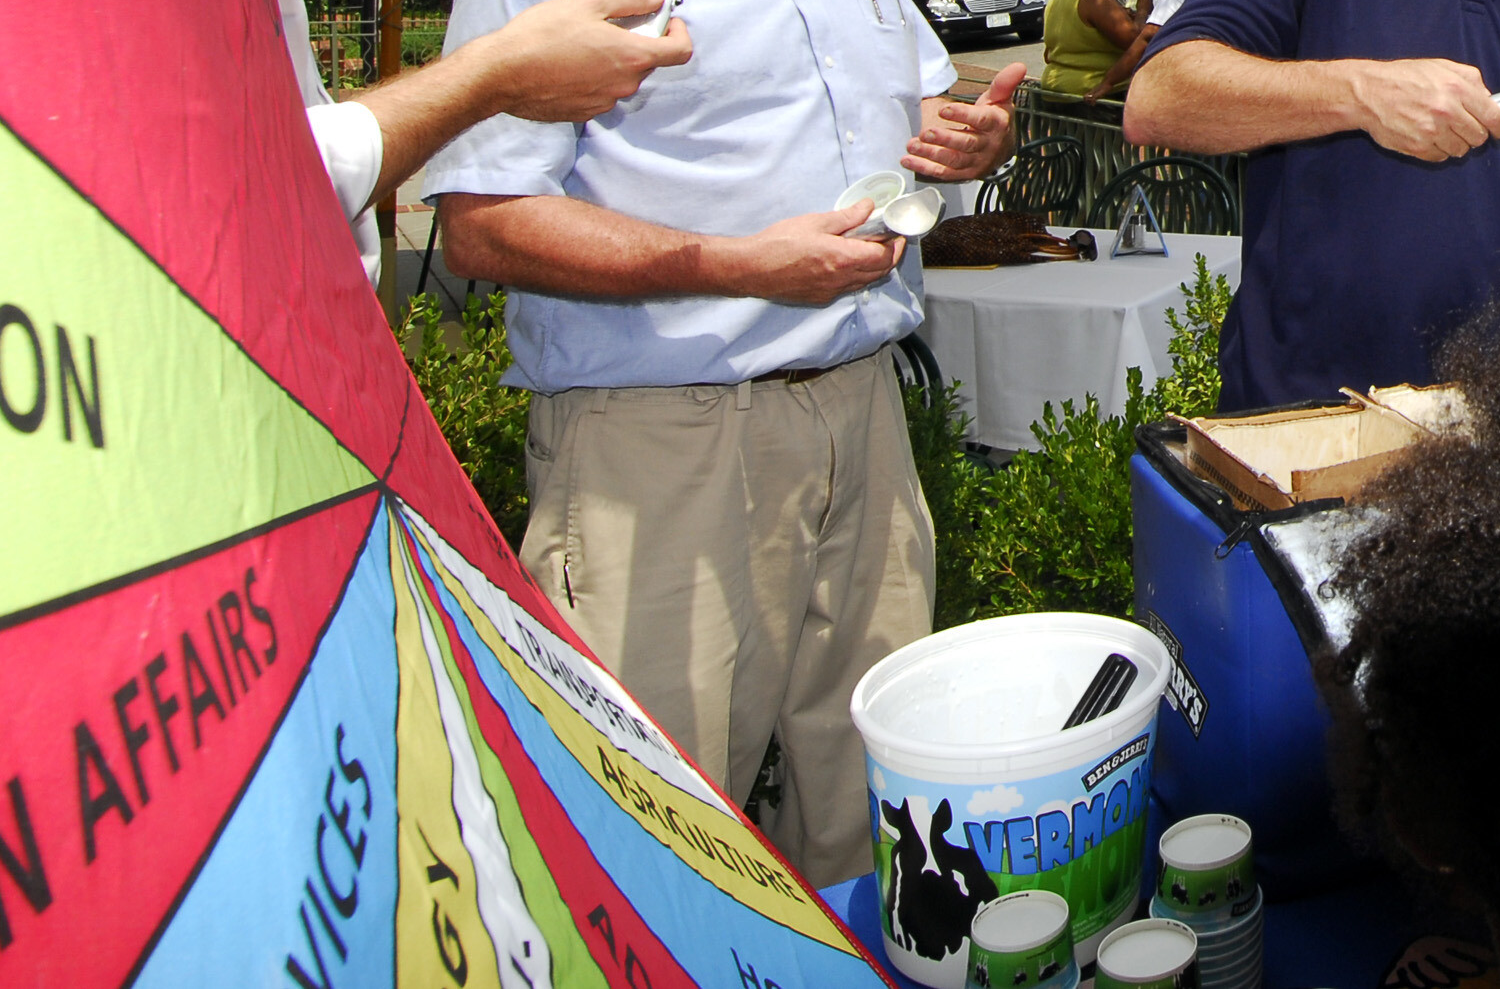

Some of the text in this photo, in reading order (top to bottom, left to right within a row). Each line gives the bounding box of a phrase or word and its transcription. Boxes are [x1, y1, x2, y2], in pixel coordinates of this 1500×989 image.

[73, 566, 279, 867] AFFAIRS
[597, 745, 807, 905] AGRICULTURE
[963, 754, 1152, 876] VERMON
